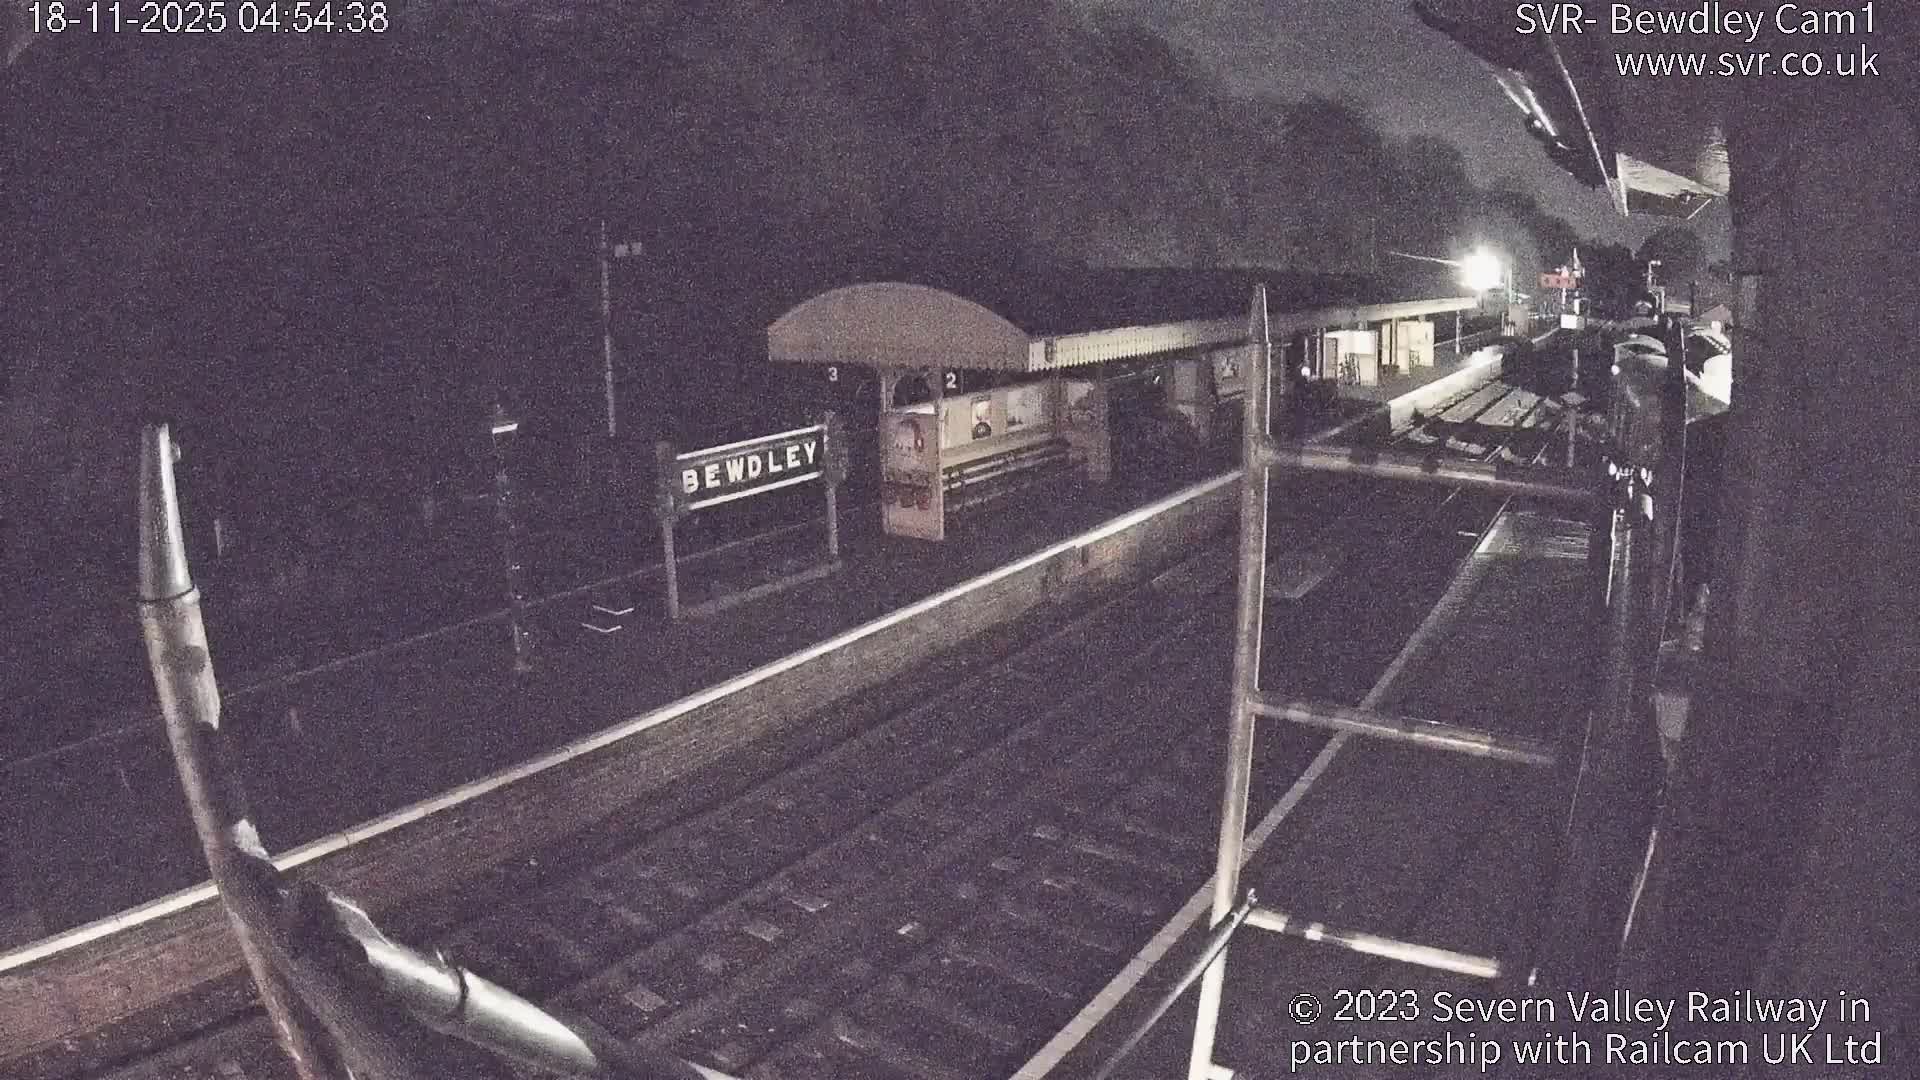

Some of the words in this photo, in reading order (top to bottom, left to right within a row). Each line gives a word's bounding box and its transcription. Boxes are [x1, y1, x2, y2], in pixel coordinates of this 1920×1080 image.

[828, 366, 839, 382] 3
[945, 372, 957, 389] 2
[682, 440, 817, 494] BEWDLEY
